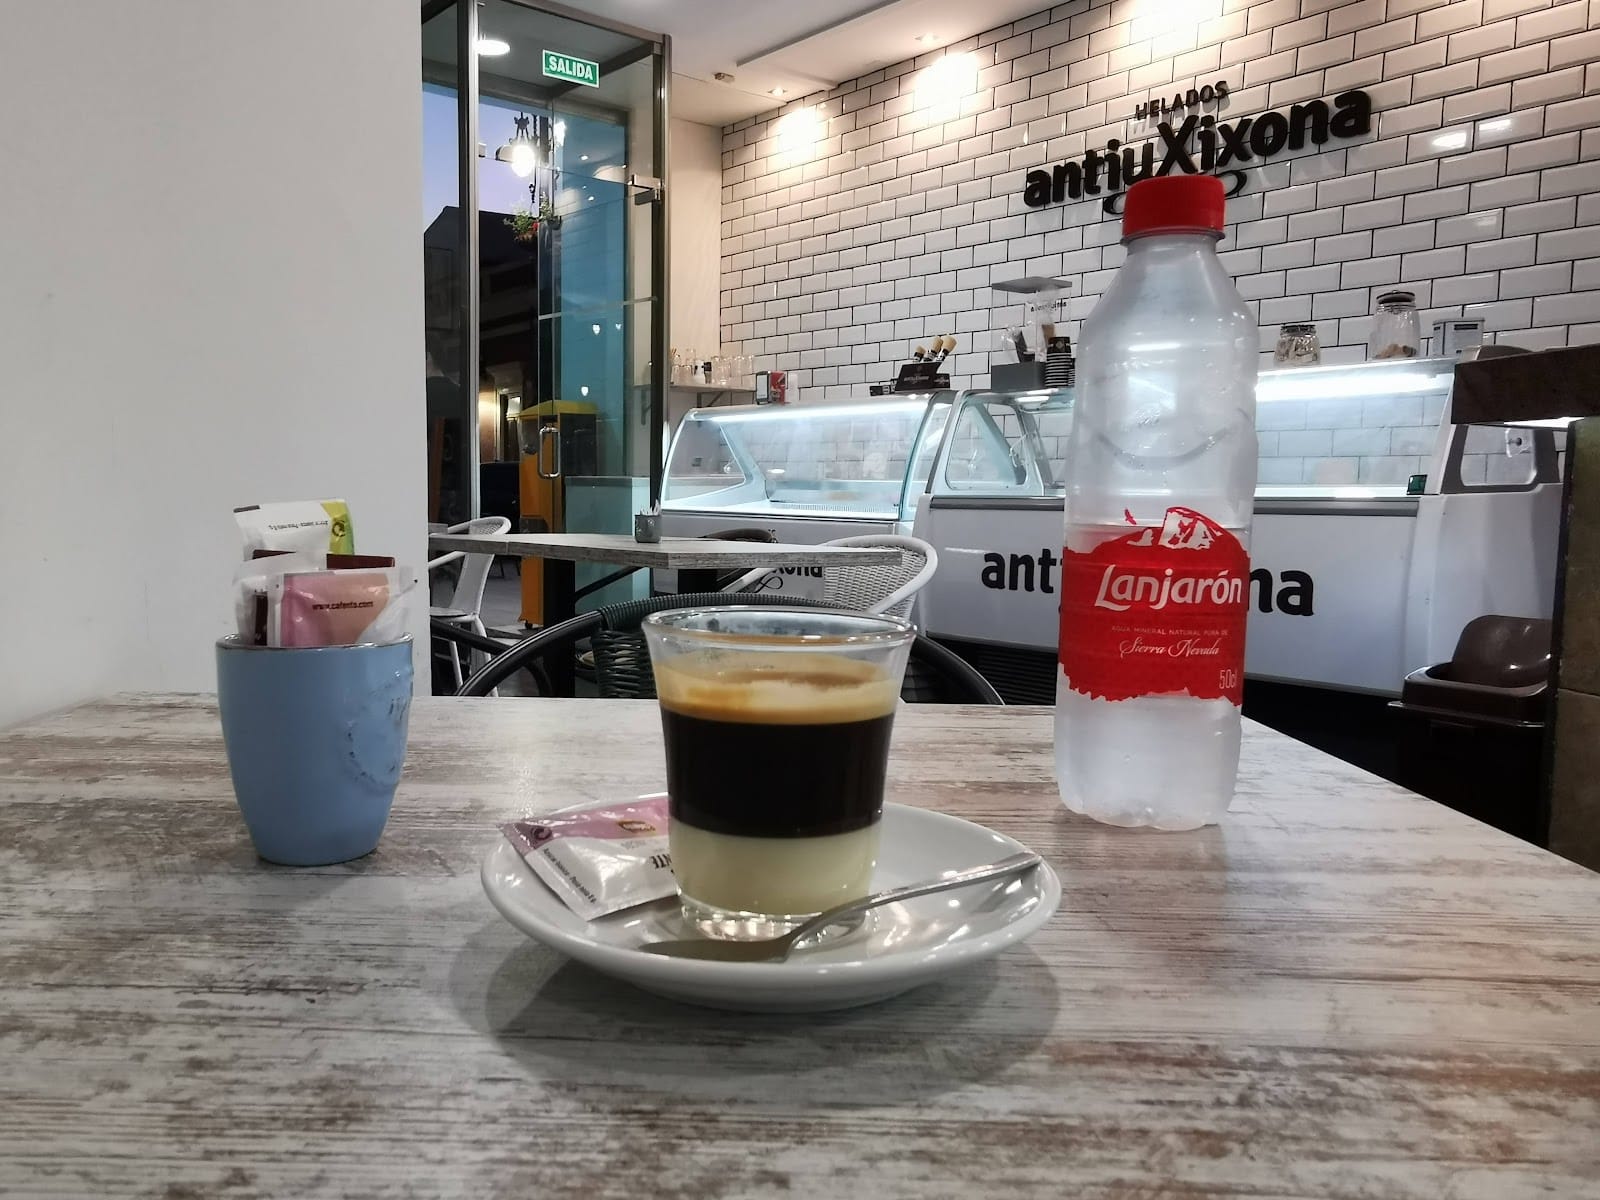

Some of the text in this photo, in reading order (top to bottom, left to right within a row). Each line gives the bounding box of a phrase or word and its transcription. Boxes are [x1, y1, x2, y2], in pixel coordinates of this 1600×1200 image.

[549, 55, 593, 80] SALIDA
[1135, 80, 1228, 121] HELADOS
[1024, 90, 1371, 207] antiuXixona
[981, 548, 1062, 594] ant
[1094, 564, 1242, 611] Lanjarón
[1119, 637, 1222, 659] Sierra Nevada
[1133, 627, 1166, 635] MINERAL
